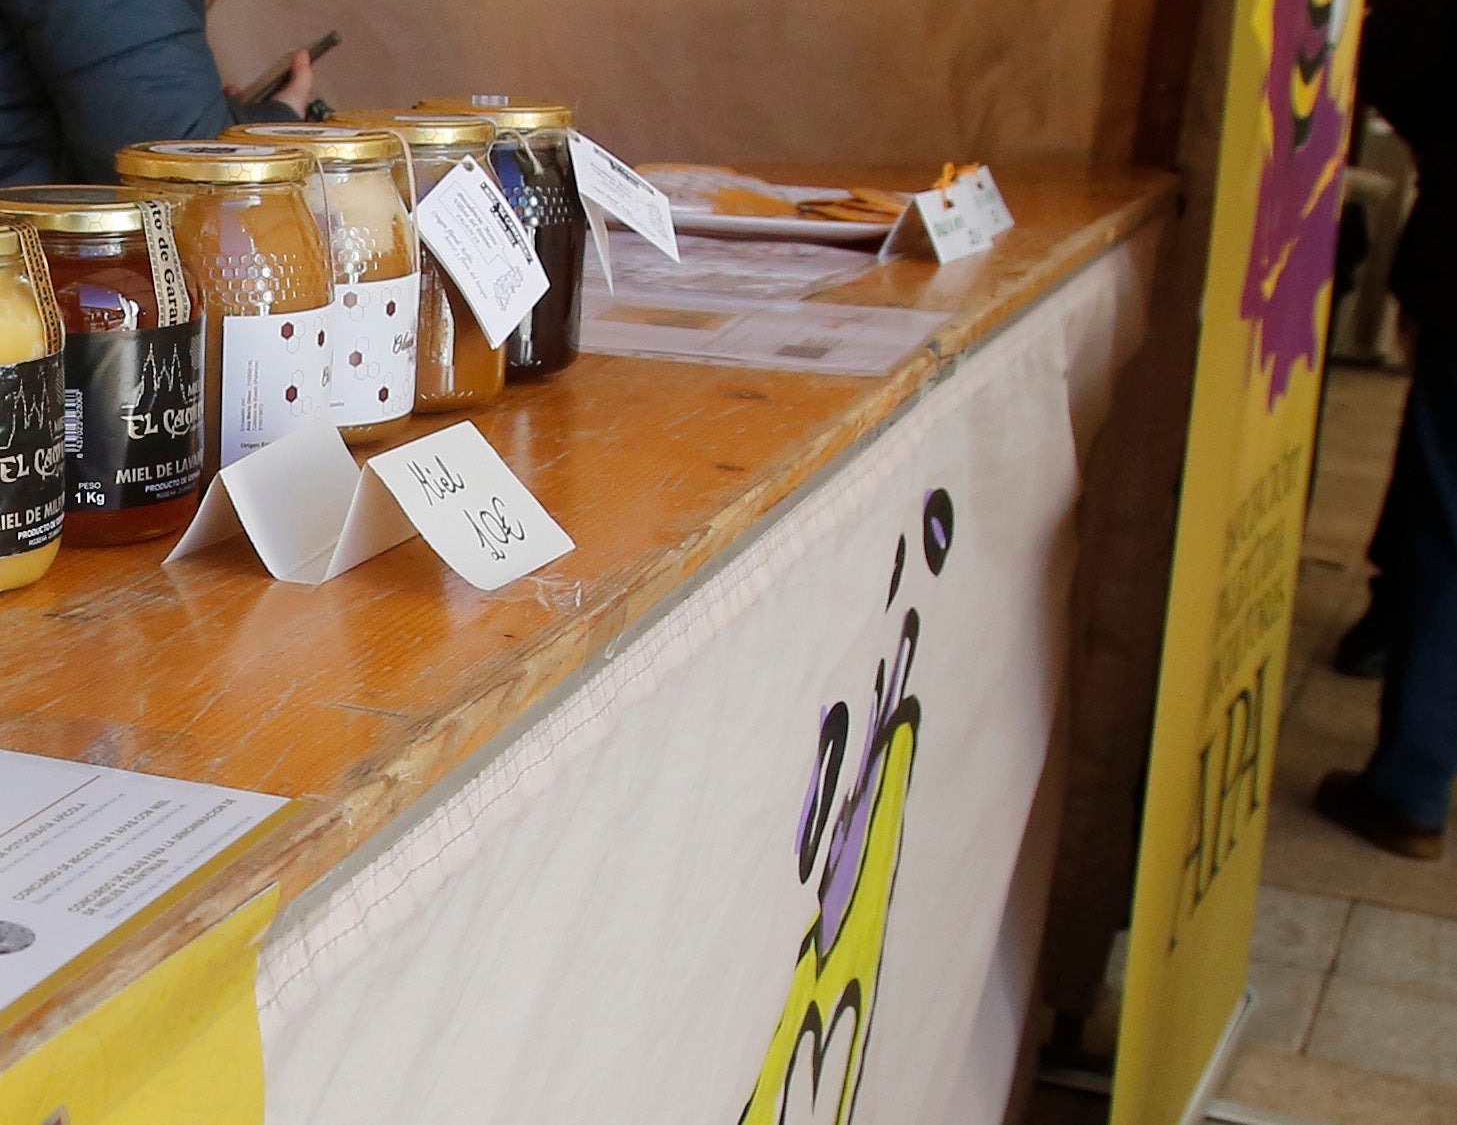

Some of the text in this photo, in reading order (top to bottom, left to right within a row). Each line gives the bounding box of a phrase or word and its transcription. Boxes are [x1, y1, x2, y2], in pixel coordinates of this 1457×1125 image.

[146, 201, 162, 230] nto
[158, 236, 169, 262] de
[115, 467, 152, 484] MIEL
[156, 462, 173, 478] DE
[407, 455, 465, 507] Miel
[78, 482, 101, 490] PESO
[75, 492, 105, 506] 1 Kg
[25, 506, 41, 523] DE
